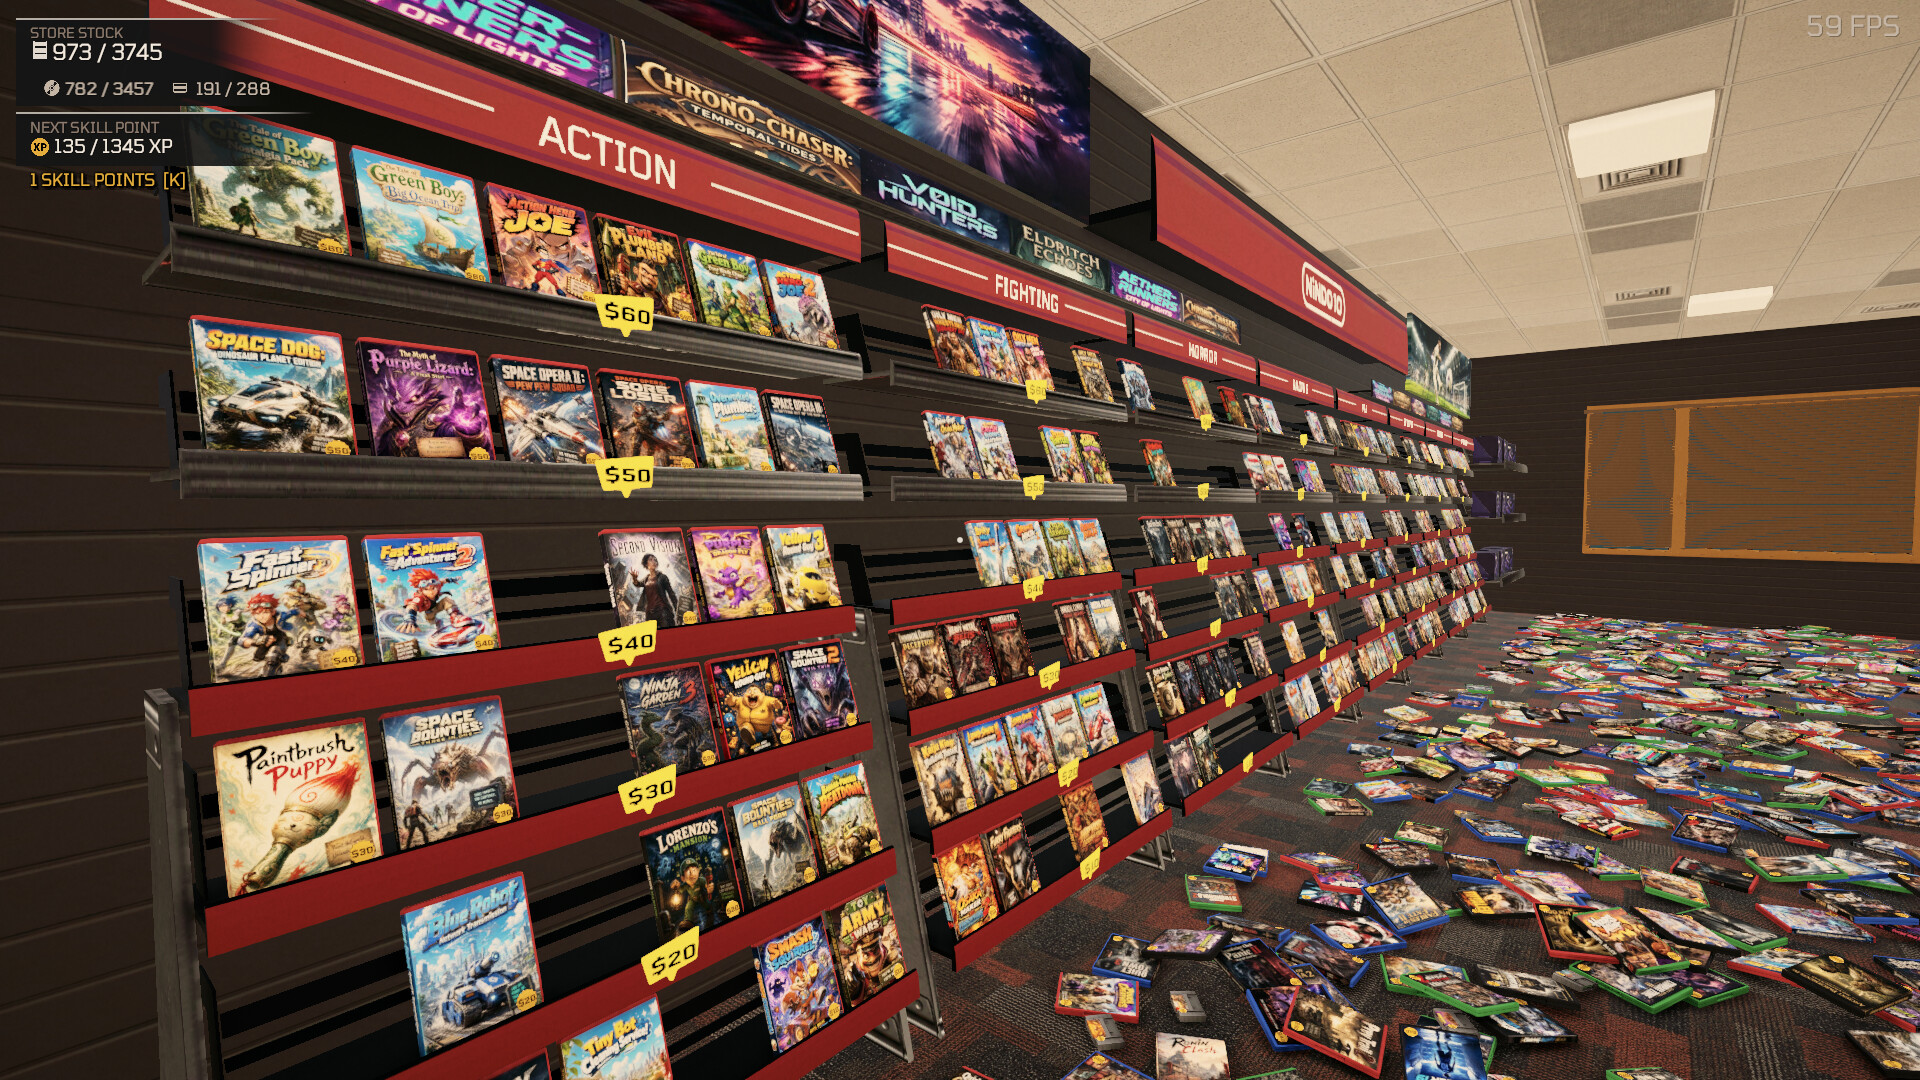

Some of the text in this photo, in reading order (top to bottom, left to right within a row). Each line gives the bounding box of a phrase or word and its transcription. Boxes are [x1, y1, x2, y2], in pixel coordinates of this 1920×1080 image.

[397, 3, 568, 77] OF LIGHTS
[635, 61, 854, 169] CHRONO-CHASER:
[202, 117, 279, 152] Green
[249, 124, 270, 137] Tale
[271, 130, 284, 140] of
[691, 103, 816, 162] TEMPORAL TIDES
[227, 141, 310, 169] Nostalgia Pack
[538, 116, 676, 189] ACTION
[370, 164, 427, 191] Green
[385, 185, 408, 201] Big
[441, 199, 461, 213] Trip
[507, 196, 577, 218] ACTION HERO
[902, 173, 978, 219] VOID
[878, 179, 999, 241] HUNTERS
[503, 209, 577, 237] JOE
[625, 225, 658, 242] EVIL
[608, 226, 676, 260] PLUMBER
[624, 242, 669, 265] LAND
[1022, 224, 1101, 271] ELDRITCH
[698, 248, 731, 271] Green
[731, 258, 751, 276] Boy
[1033, 243, 1094, 280] ECHOES
[777, 278, 817, 298] JOE 2
[995, 273, 1060, 314] FIGHTING
[1118, 280, 1179, 313] RUNNERS
[605, 301, 651, 326] $60
[206, 329, 278, 353] SPACE
[217, 351, 322, 368] DINOSAUR PLANET EDITION
[367, 348, 424, 375] Purple
[399, 349, 437, 361] The Myth of
[502, 364, 537, 381] SPACE
[537, 368, 572, 383] OPERA
[614, 375, 638, 383] SPACE
[515, 380, 576, 393] PEW PEW SQUAD
[609, 388, 679, 405] LOSER
[614, 380, 669, 395] SORE
[1029, 384, 1047, 396] $60
[771, 396, 794, 410] SPACE
[793, 399, 815, 413] OPERA
[605, 466, 651, 484] $50
[1027, 482, 1044, 492] $50
[610, 536, 682, 556] SECOND VISION
[703, 539, 753, 549] PURPLE
[779, 531, 812, 546] Yellow
[813, 529, 825, 552] 3
[236, 546, 304, 570] Fast
[380, 541, 474, 568] Fast Spinner 2
[223, 559, 317, 594] Spinner
[1027, 584, 1044, 594] $40
[991, 620, 1018, 632] COMBAT
[608, 634, 654, 654] $40
[792, 645, 840, 665] SPACE 2
[640, 676, 697, 705] NINJA 3
[641, 689, 683, 708] GARDEN
[415, 708, 476, 731] SPACE
[233, 733, 355, 785] Paintbrush
[264, 754, 338, 796] Puppy
[628, 779, 674, 805] $30
[751, 796, 777, 810] SPACE
[752, 818, 769, 829] BALL
[656, 818, 719, 854] LORENZO'S
[672, 834, 709, 854] MANSION
[1085, 857, 1099, 875] $10
[424, 879, 520, 947] Blue Robot
[848, 895, 870, 911] TOY
[840, 900, 886, 937] ARMY
[767, 926, 814, 962] SMASH
[651, 943, 696, 976] $20
[1121, 960, 1149, 972] TOWN
[1120, 966, 1148, 978] QUIET
[583, 1016, 637, 1056] Tiny Bot
